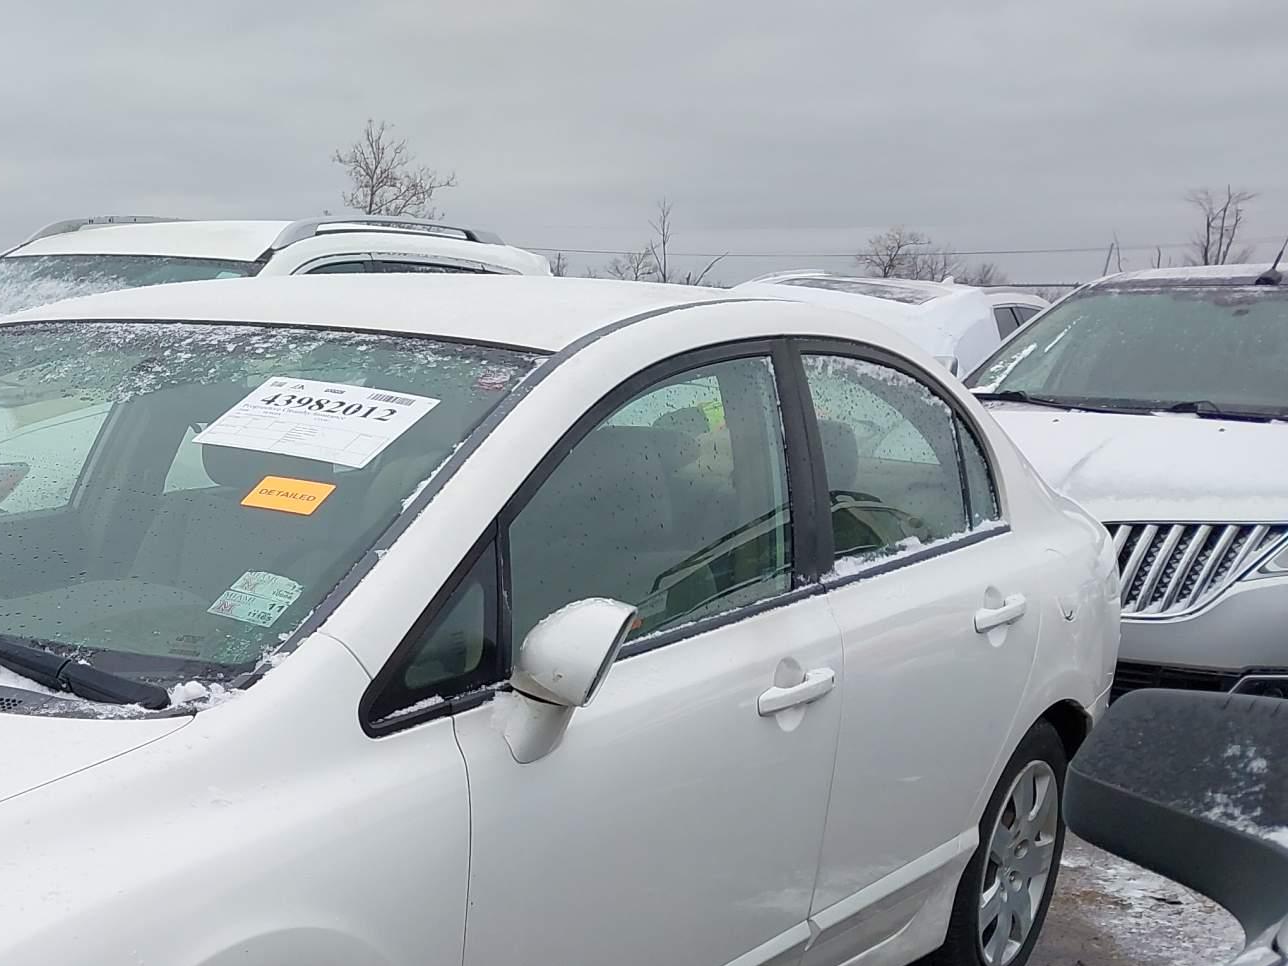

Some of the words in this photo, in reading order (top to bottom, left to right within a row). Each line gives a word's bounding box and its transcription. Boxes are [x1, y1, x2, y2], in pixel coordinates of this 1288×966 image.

[260, 392, 397, 422] 43982012
[258, 488, 316, 502] DETAILED
[268, 603, 285, 613] 11
